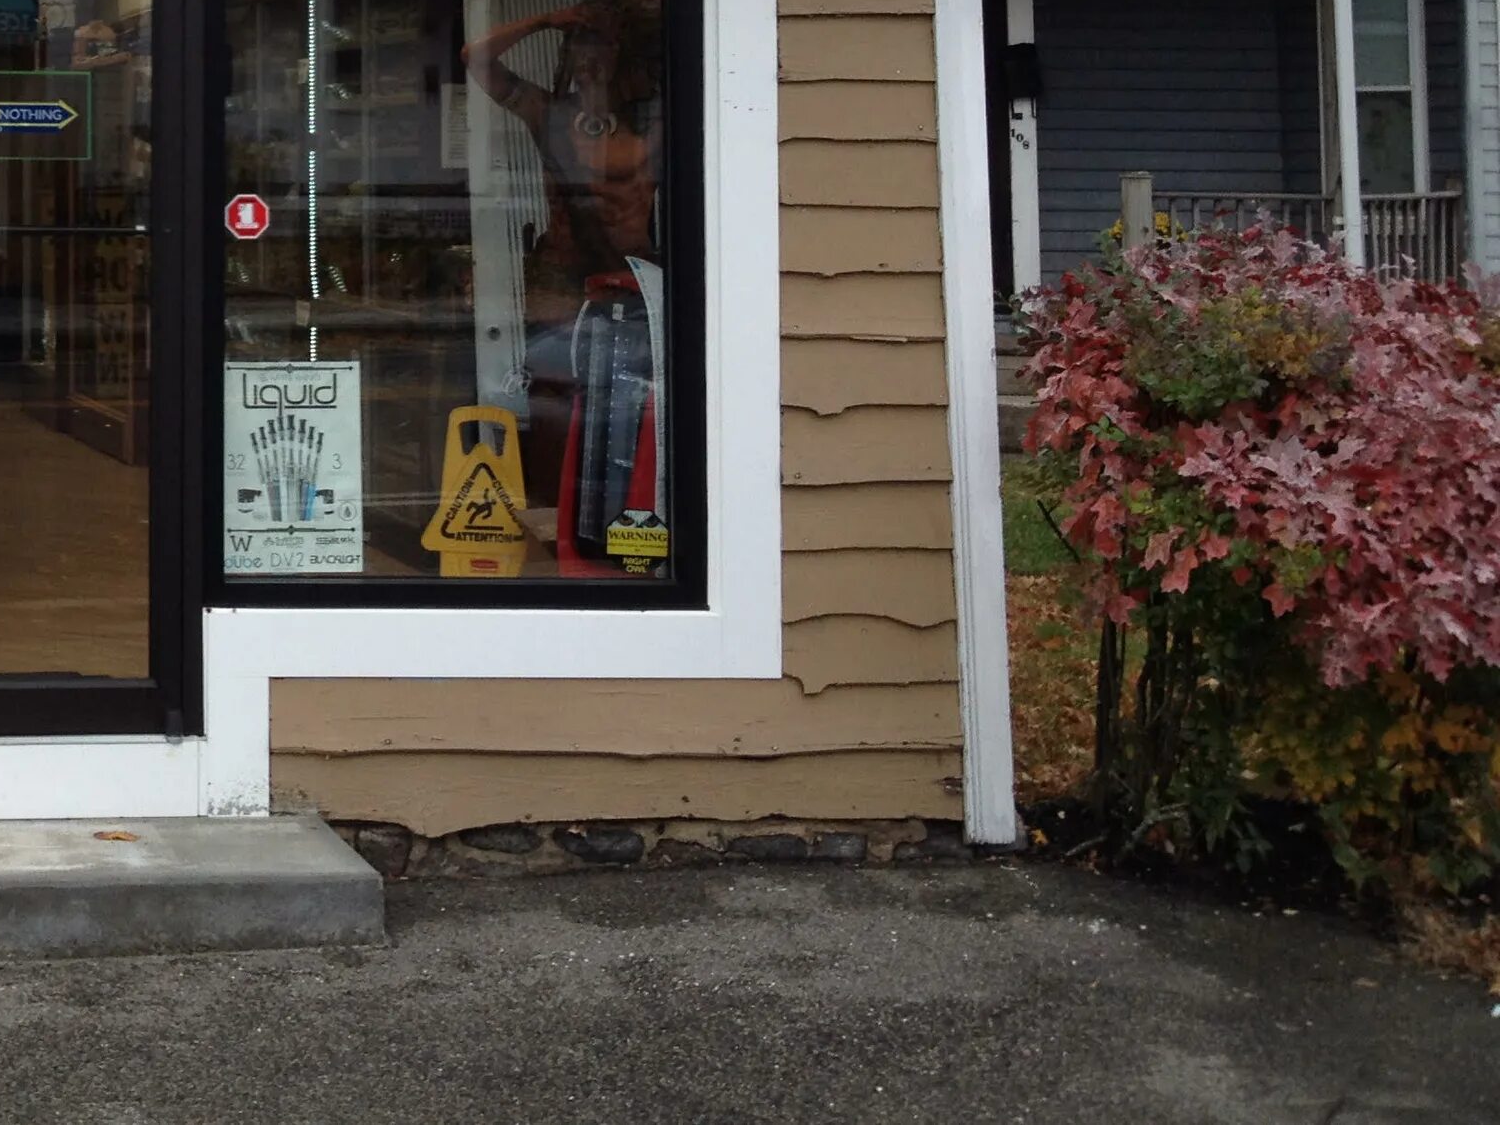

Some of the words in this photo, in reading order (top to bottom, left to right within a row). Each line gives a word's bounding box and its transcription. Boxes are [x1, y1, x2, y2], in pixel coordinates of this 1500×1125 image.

[1010, 128, 1030, 150] 108
[226, 453, 246, 471] 32
[331, 453, 343, 470] 3
[446, 479, 476, 521] CAUTION
[455, 531, 513, 543] ATTENTION
[608, 530, 668, 542] WARNING
